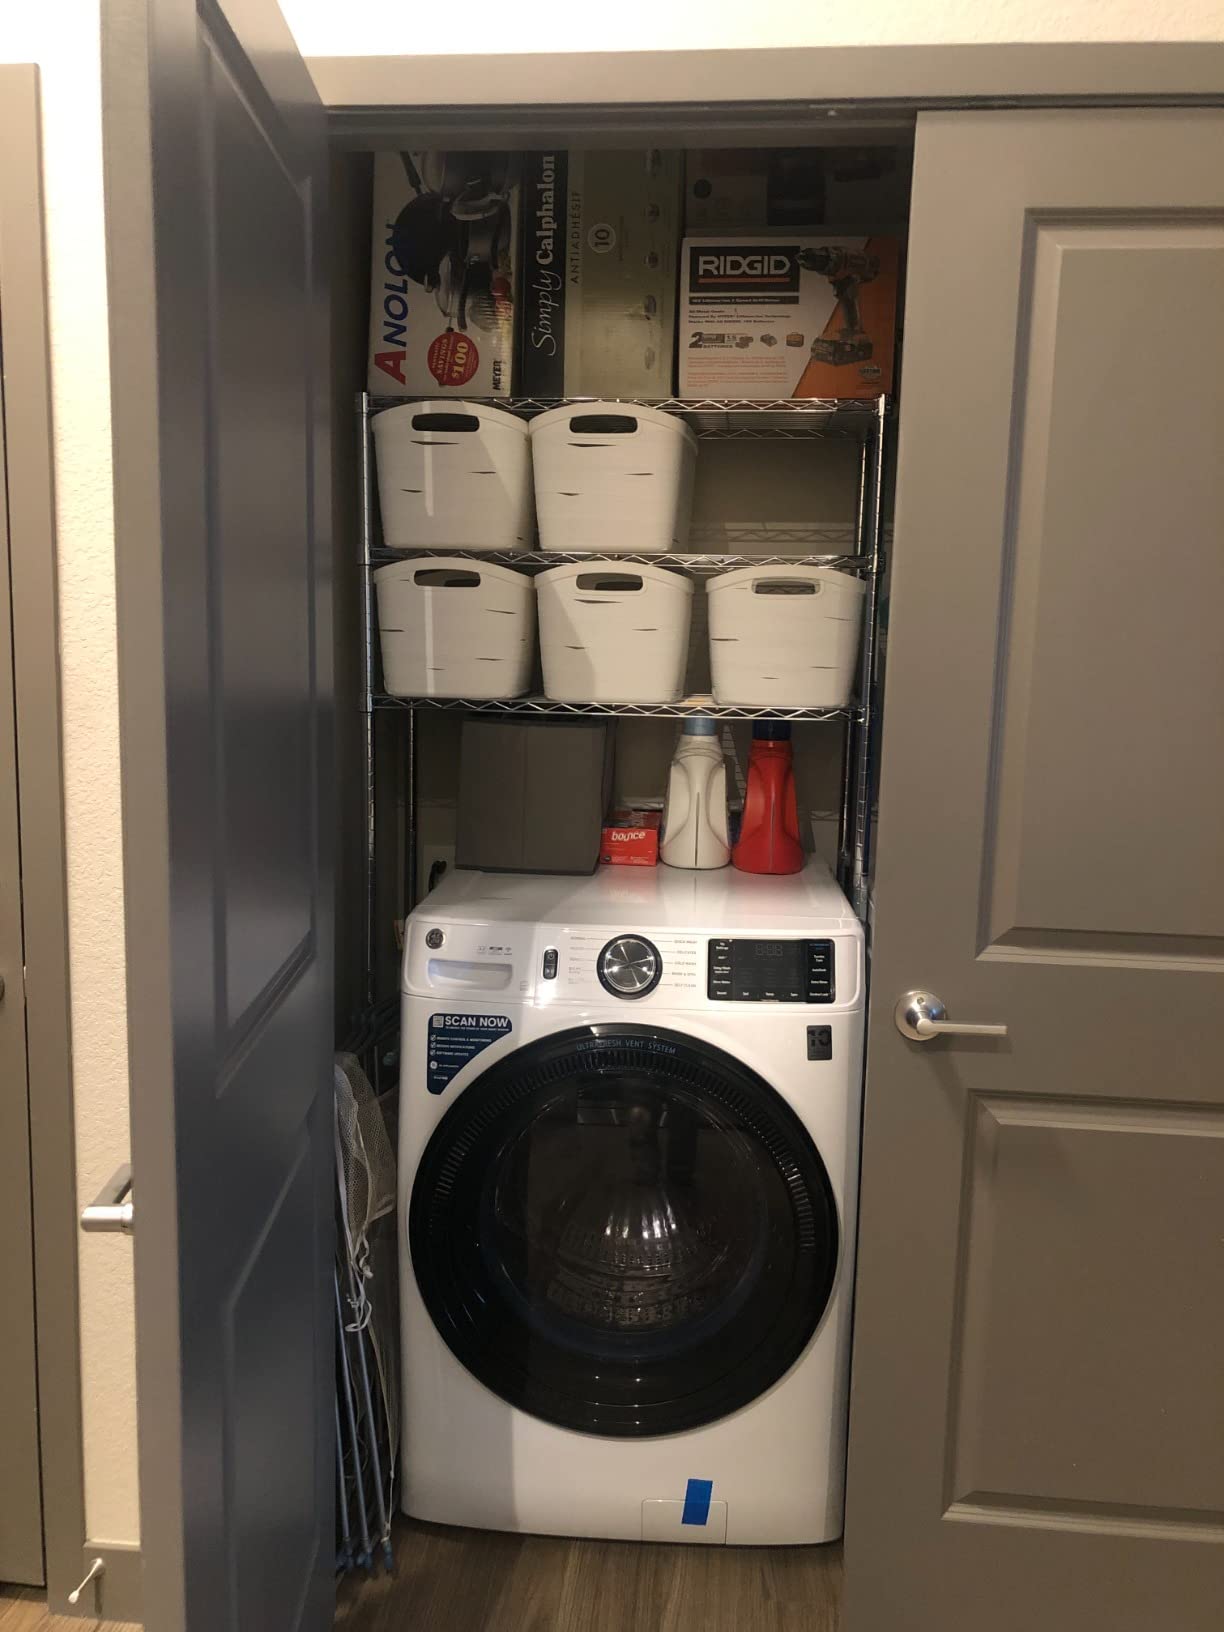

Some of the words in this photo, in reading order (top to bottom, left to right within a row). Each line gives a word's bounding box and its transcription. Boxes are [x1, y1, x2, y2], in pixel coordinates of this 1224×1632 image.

[535, 155, 557, 265] Calphalon
[594, 228, 610, 247] 10
[698, 255, 791, 275] RIDGID
[531, 268, 562, 356] Simply
[688, 331, 704, 348] 2
[436, 338, 448, 375] SAVINGS
[451, 341, 469, 379] $100
[492, 360, 502, 391] MEYER
[611, 830, 646, 841] bounce
[445, 1015, 476, 1026] SCAN
[479, 1016, 508, 1027] NOW
[625, 1039, 645, 1048] VENT
[647, 1041, 677, 1054] SYSTEM
